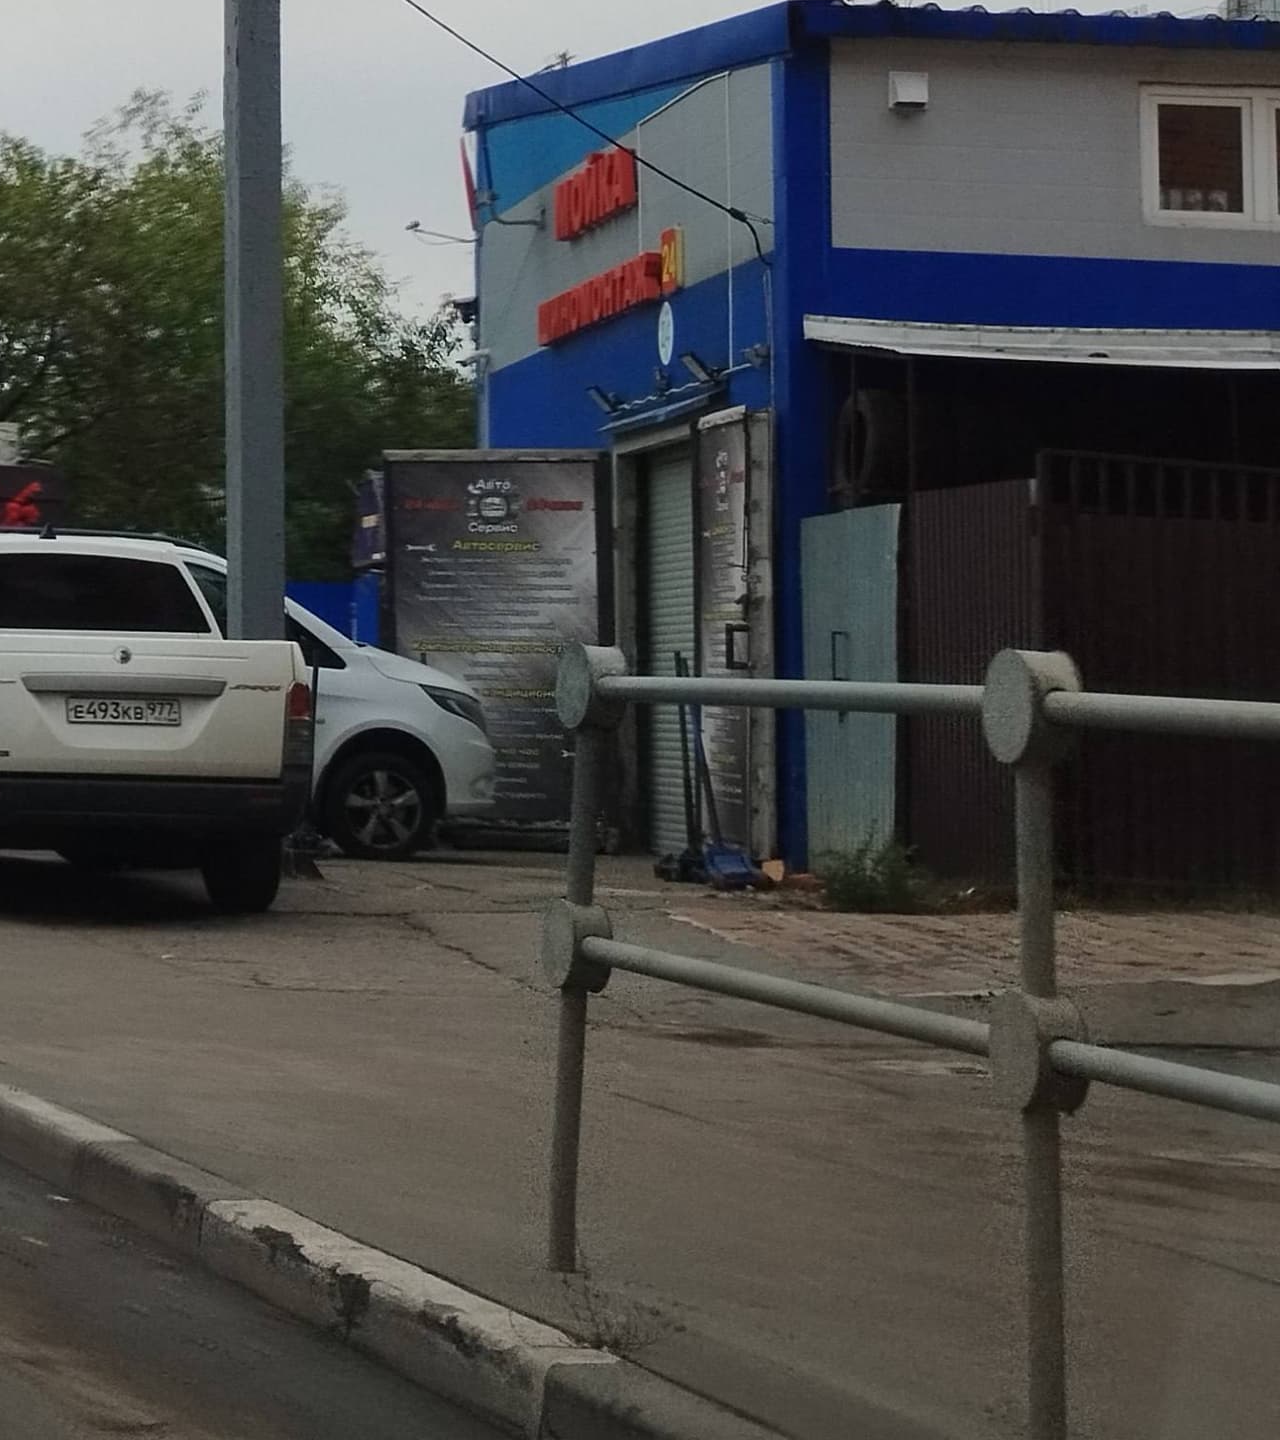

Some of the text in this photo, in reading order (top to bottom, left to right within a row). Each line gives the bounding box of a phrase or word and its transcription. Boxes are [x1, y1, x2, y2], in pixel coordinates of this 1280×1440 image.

[663, 241, 677, 283] 24
[474, 478, 511, 491] Авто
[467, 521, 518, 534] Сервис
[451, 539, 542, 553] Автосервис
